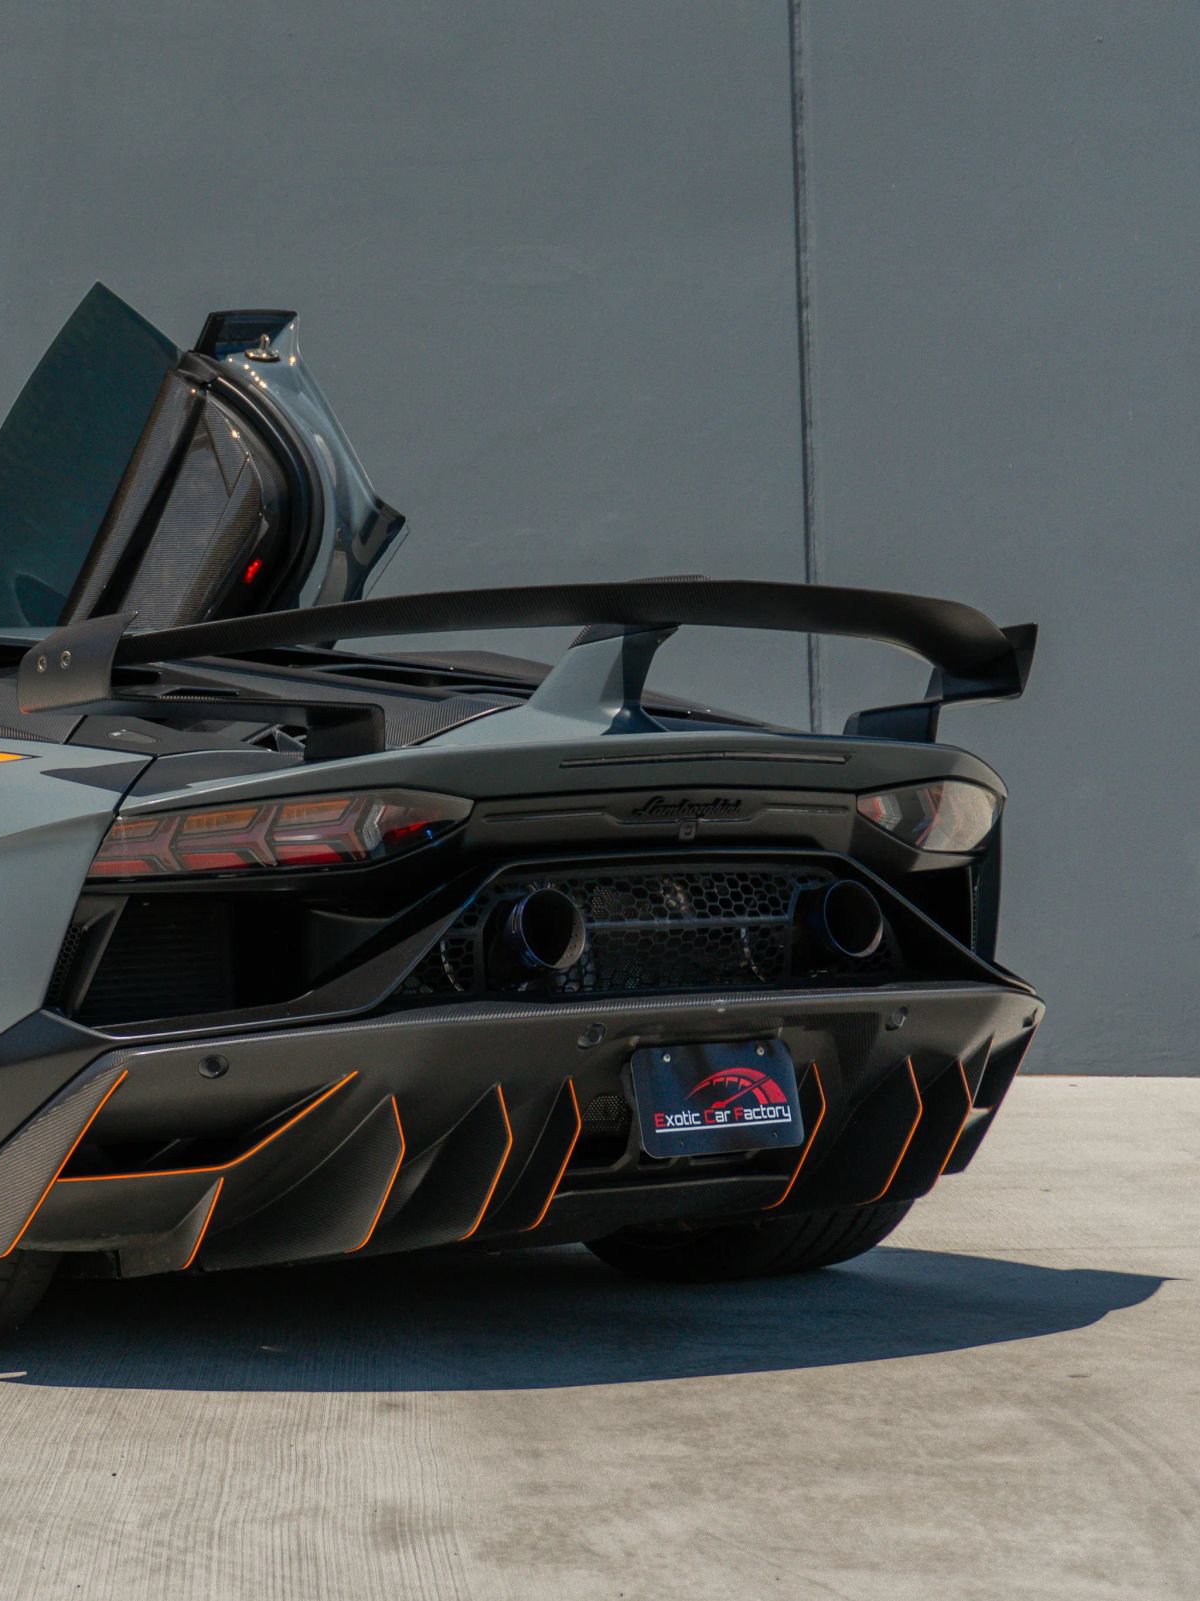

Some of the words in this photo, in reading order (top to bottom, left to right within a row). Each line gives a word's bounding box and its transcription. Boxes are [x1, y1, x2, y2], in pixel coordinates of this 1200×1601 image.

[654, 1110, 701, 1127] Exotic
[704, 1109, 731, 1123] Car
[733, 1104, 792, 1121] Factory
